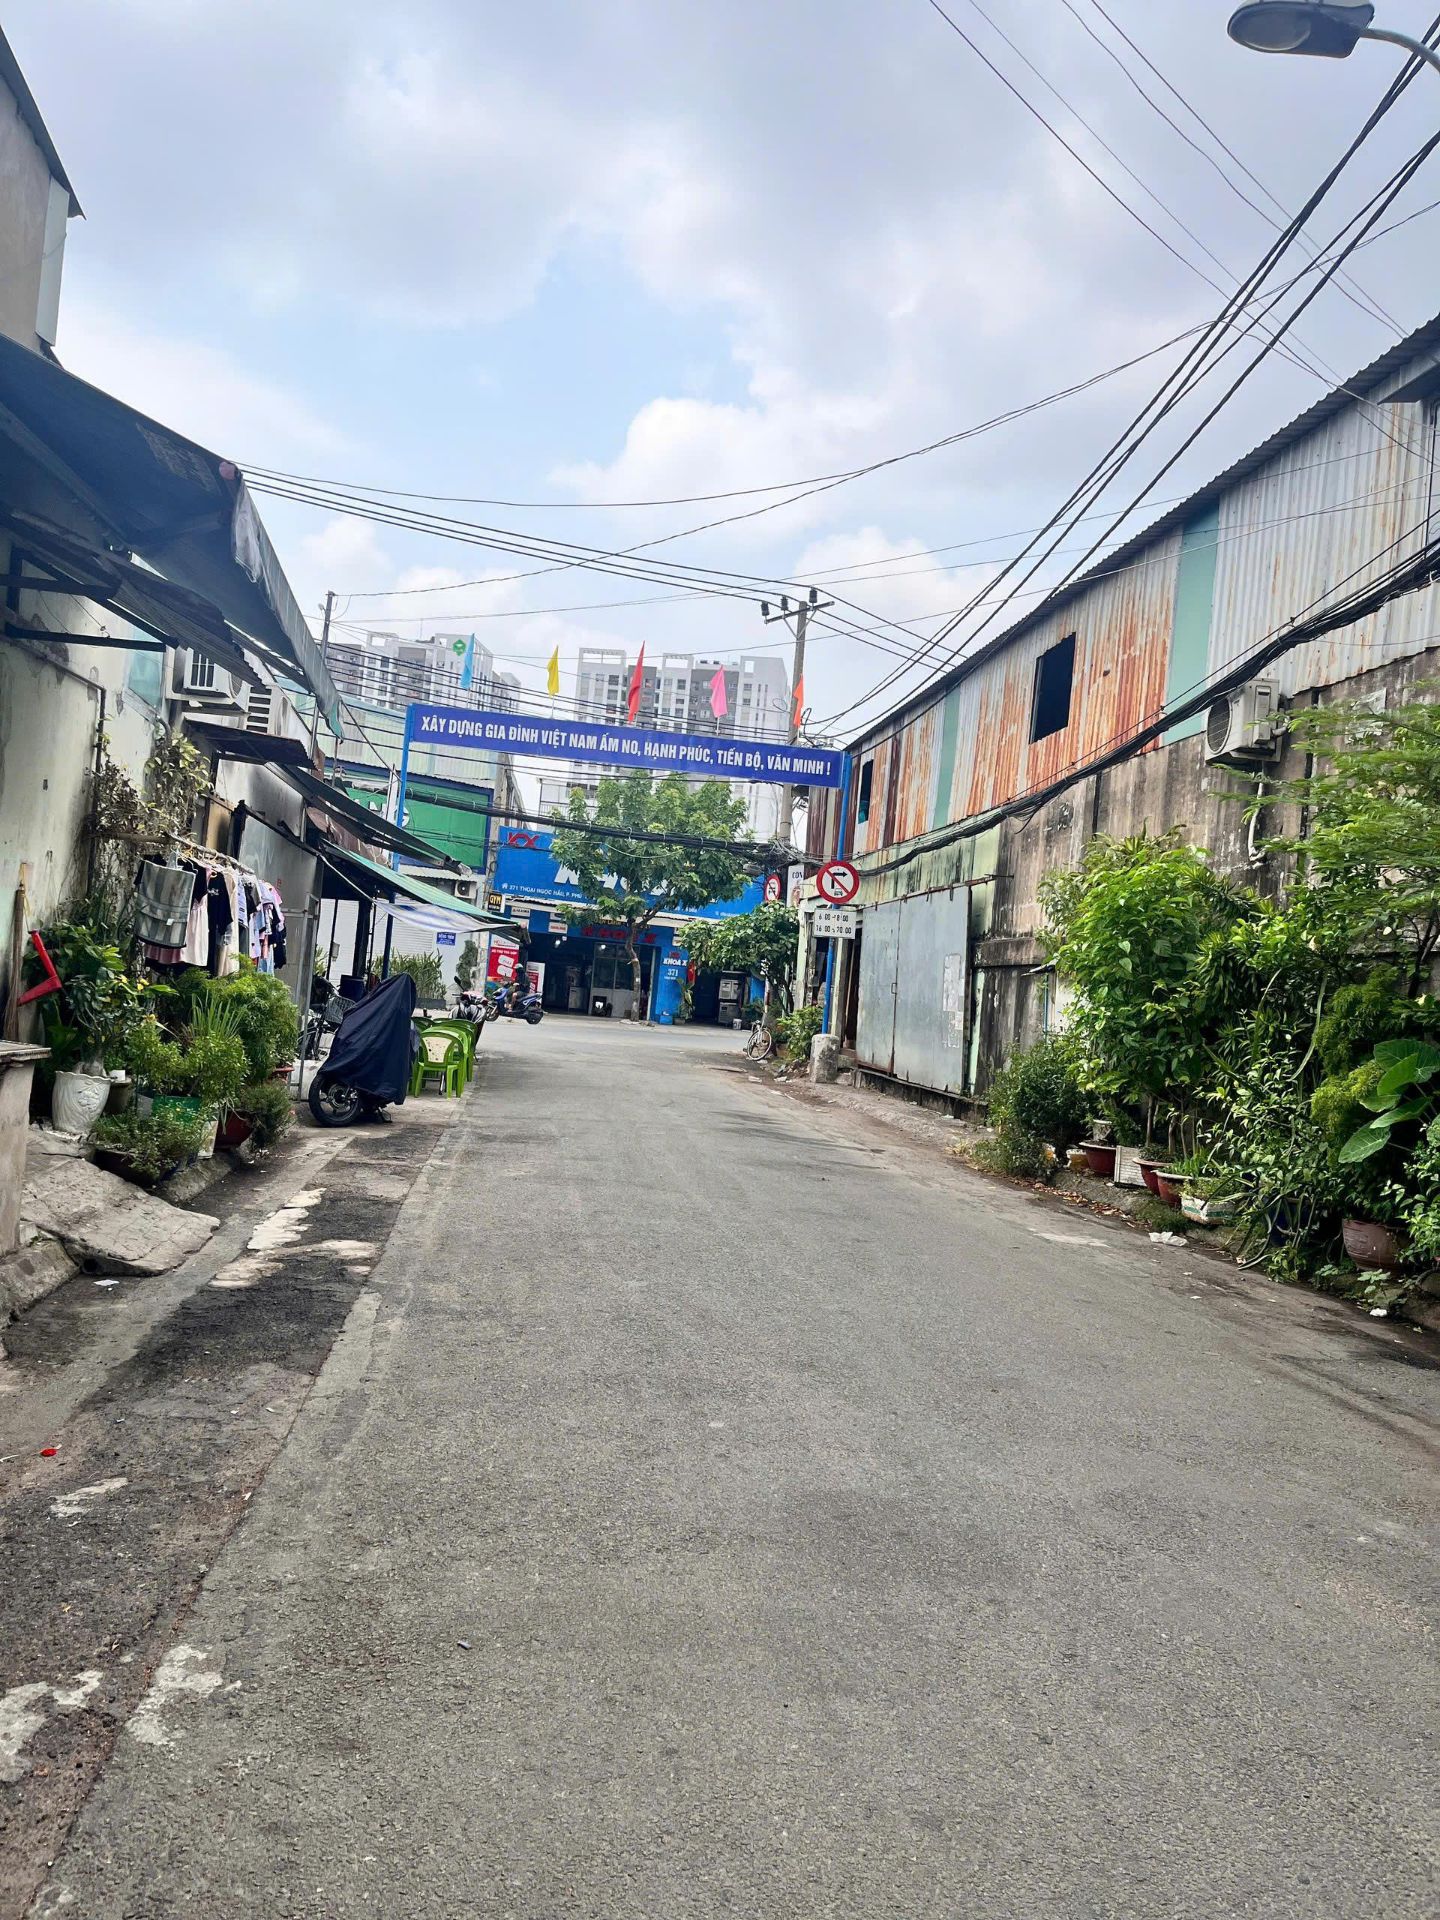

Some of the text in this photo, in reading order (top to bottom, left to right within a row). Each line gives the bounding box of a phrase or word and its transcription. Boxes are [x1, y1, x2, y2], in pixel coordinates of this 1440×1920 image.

[421, 715, 445, 733] XÂY
[448, 718, 483, 738] DỰNG
[485, 723, 506, 740] GIA
[509, 723, 539, 744] ĐÌNH
[541, 728, 568, 749] VIỆT
[569, 733, 597, 750] NAM
[600, 732, 619, 754] ẤM
[621, 739, 641, 757] NO,
[643, 742, 677, 760] HẠNH
[679, 743, 714, 765] PHÚC,
[717, 746, 743, 767] TIẾN
[745, 750, 764, 771] BỘ,
[767, 752, 790, 772] VĂN
[792, 758, 825, 776] MINH
